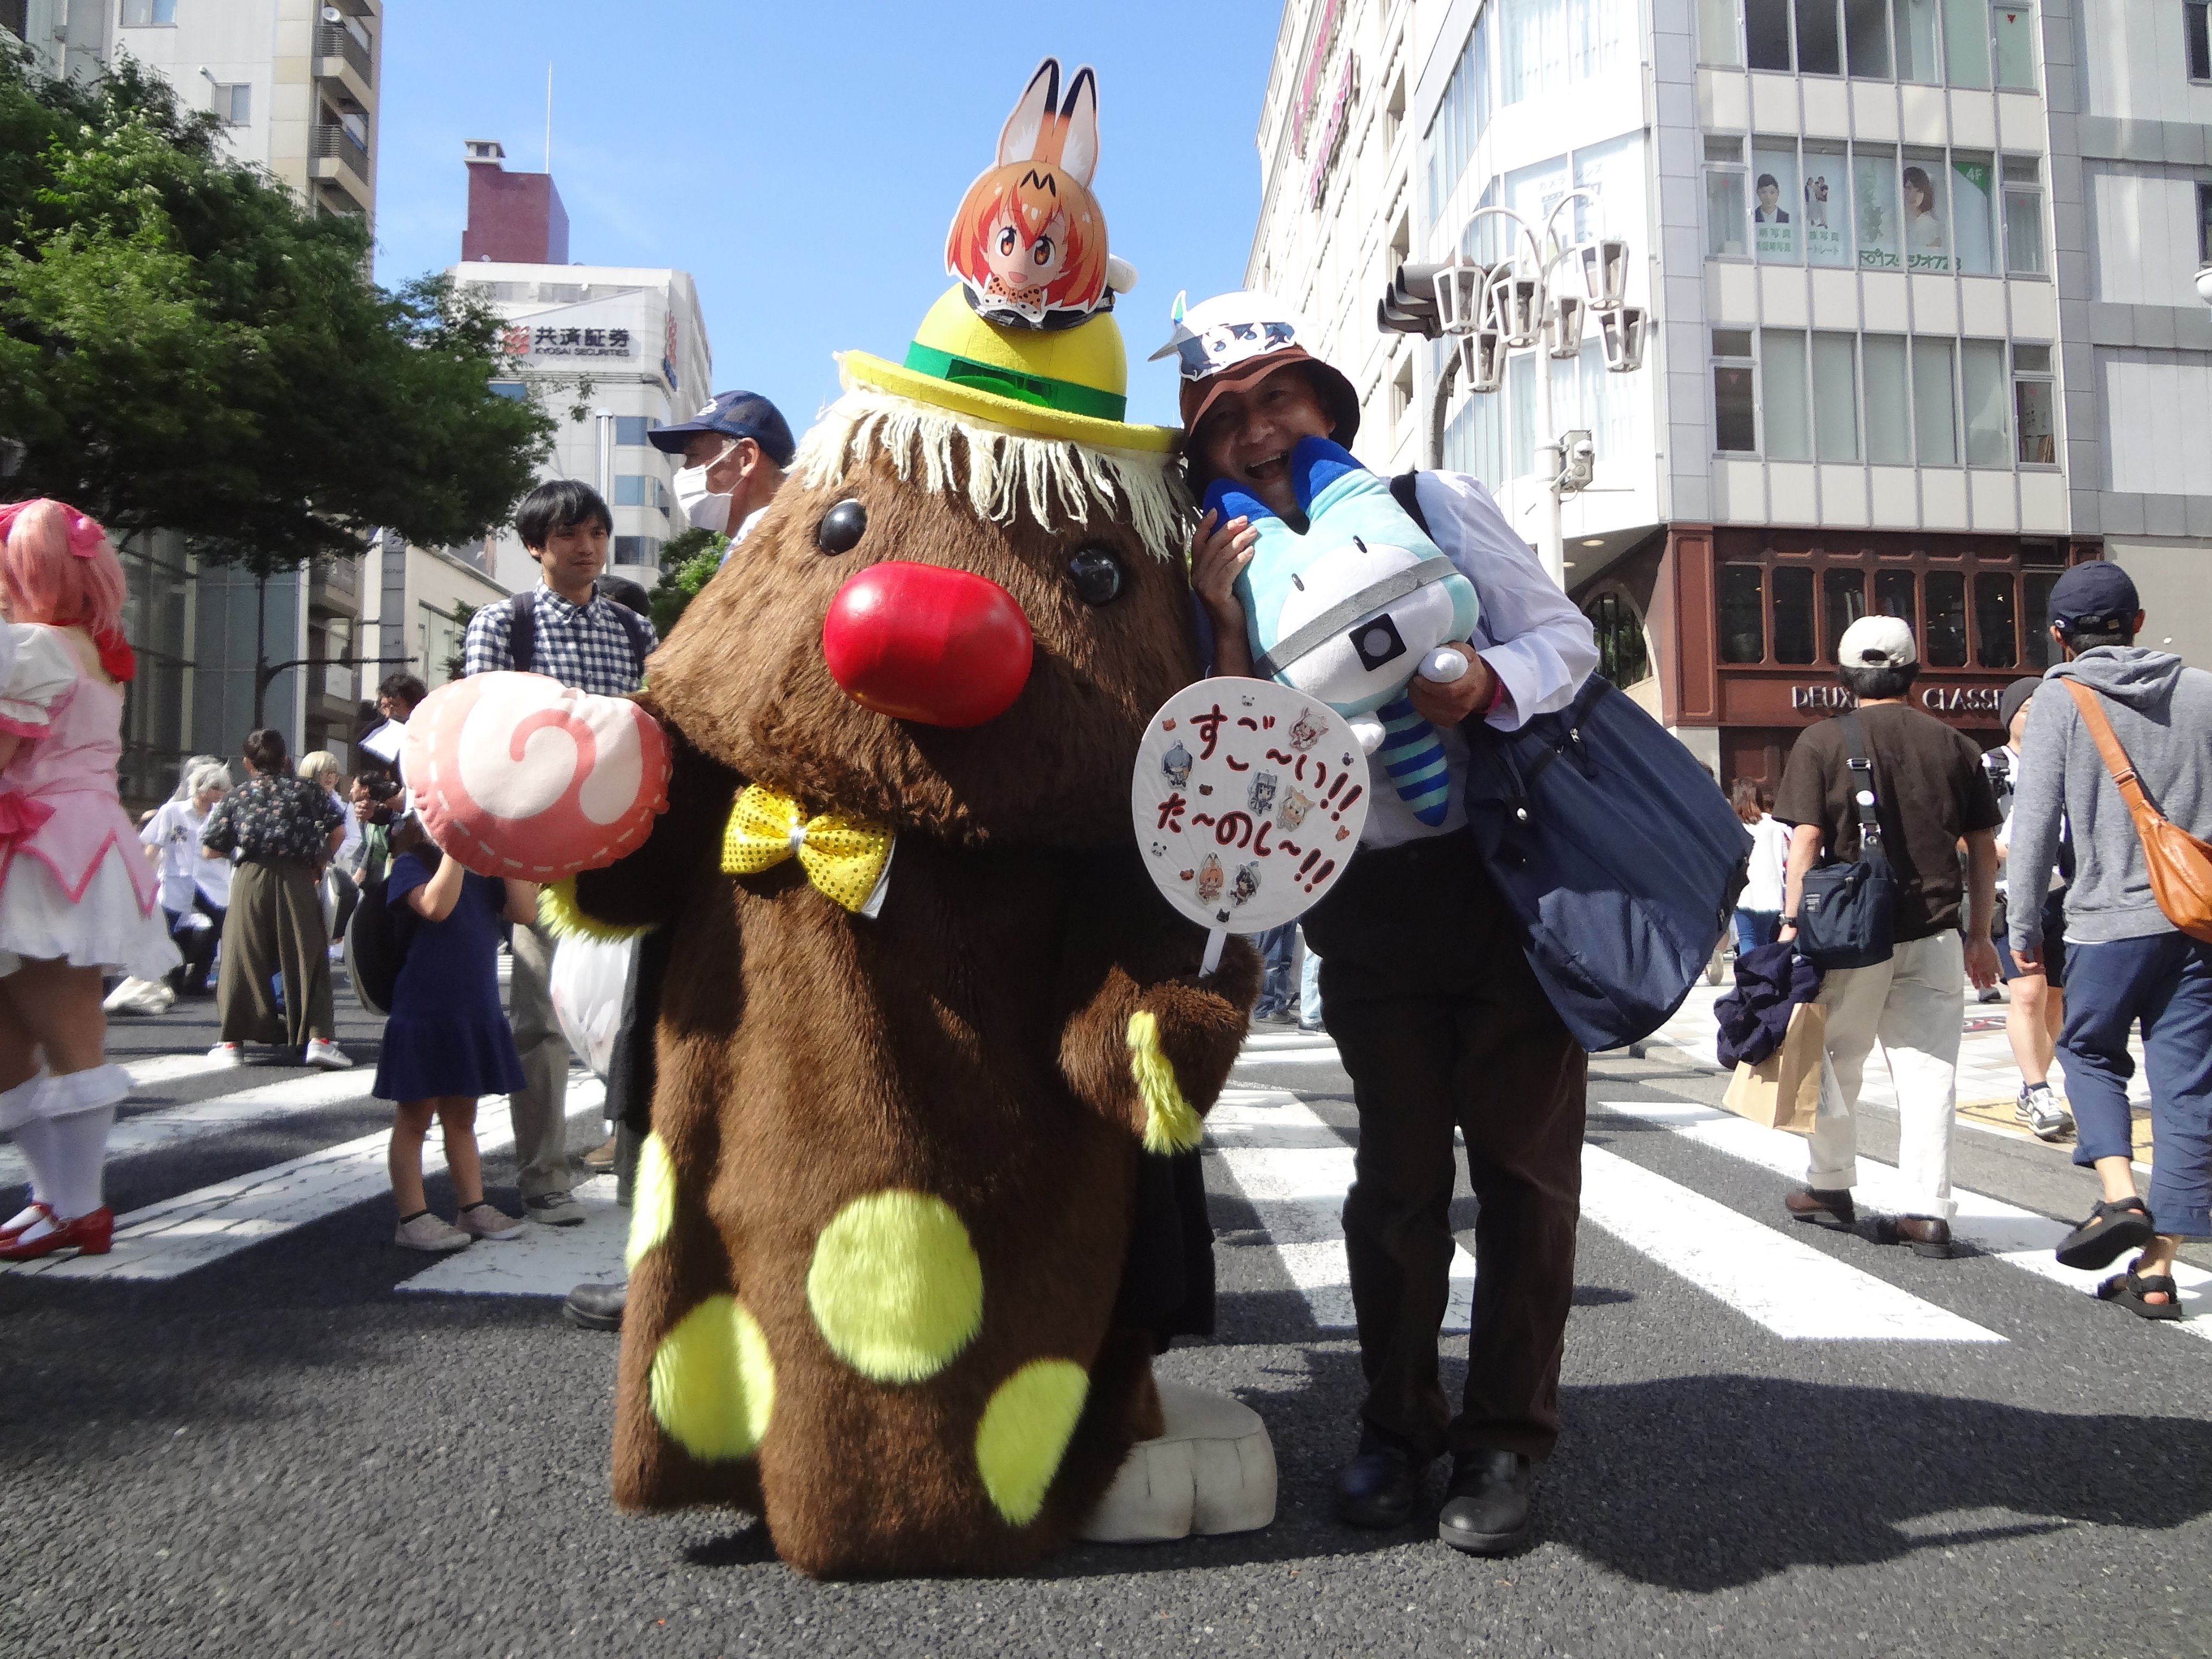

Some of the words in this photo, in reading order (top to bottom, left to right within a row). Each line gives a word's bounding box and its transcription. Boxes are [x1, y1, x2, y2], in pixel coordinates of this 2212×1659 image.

[1966, 167, 1983, 180] 4F
[535, 326, 630, 347] 共済証券
[535, 347, 571, 355] KYOSAI
[574, 348, 630, 357] SECURITIES
